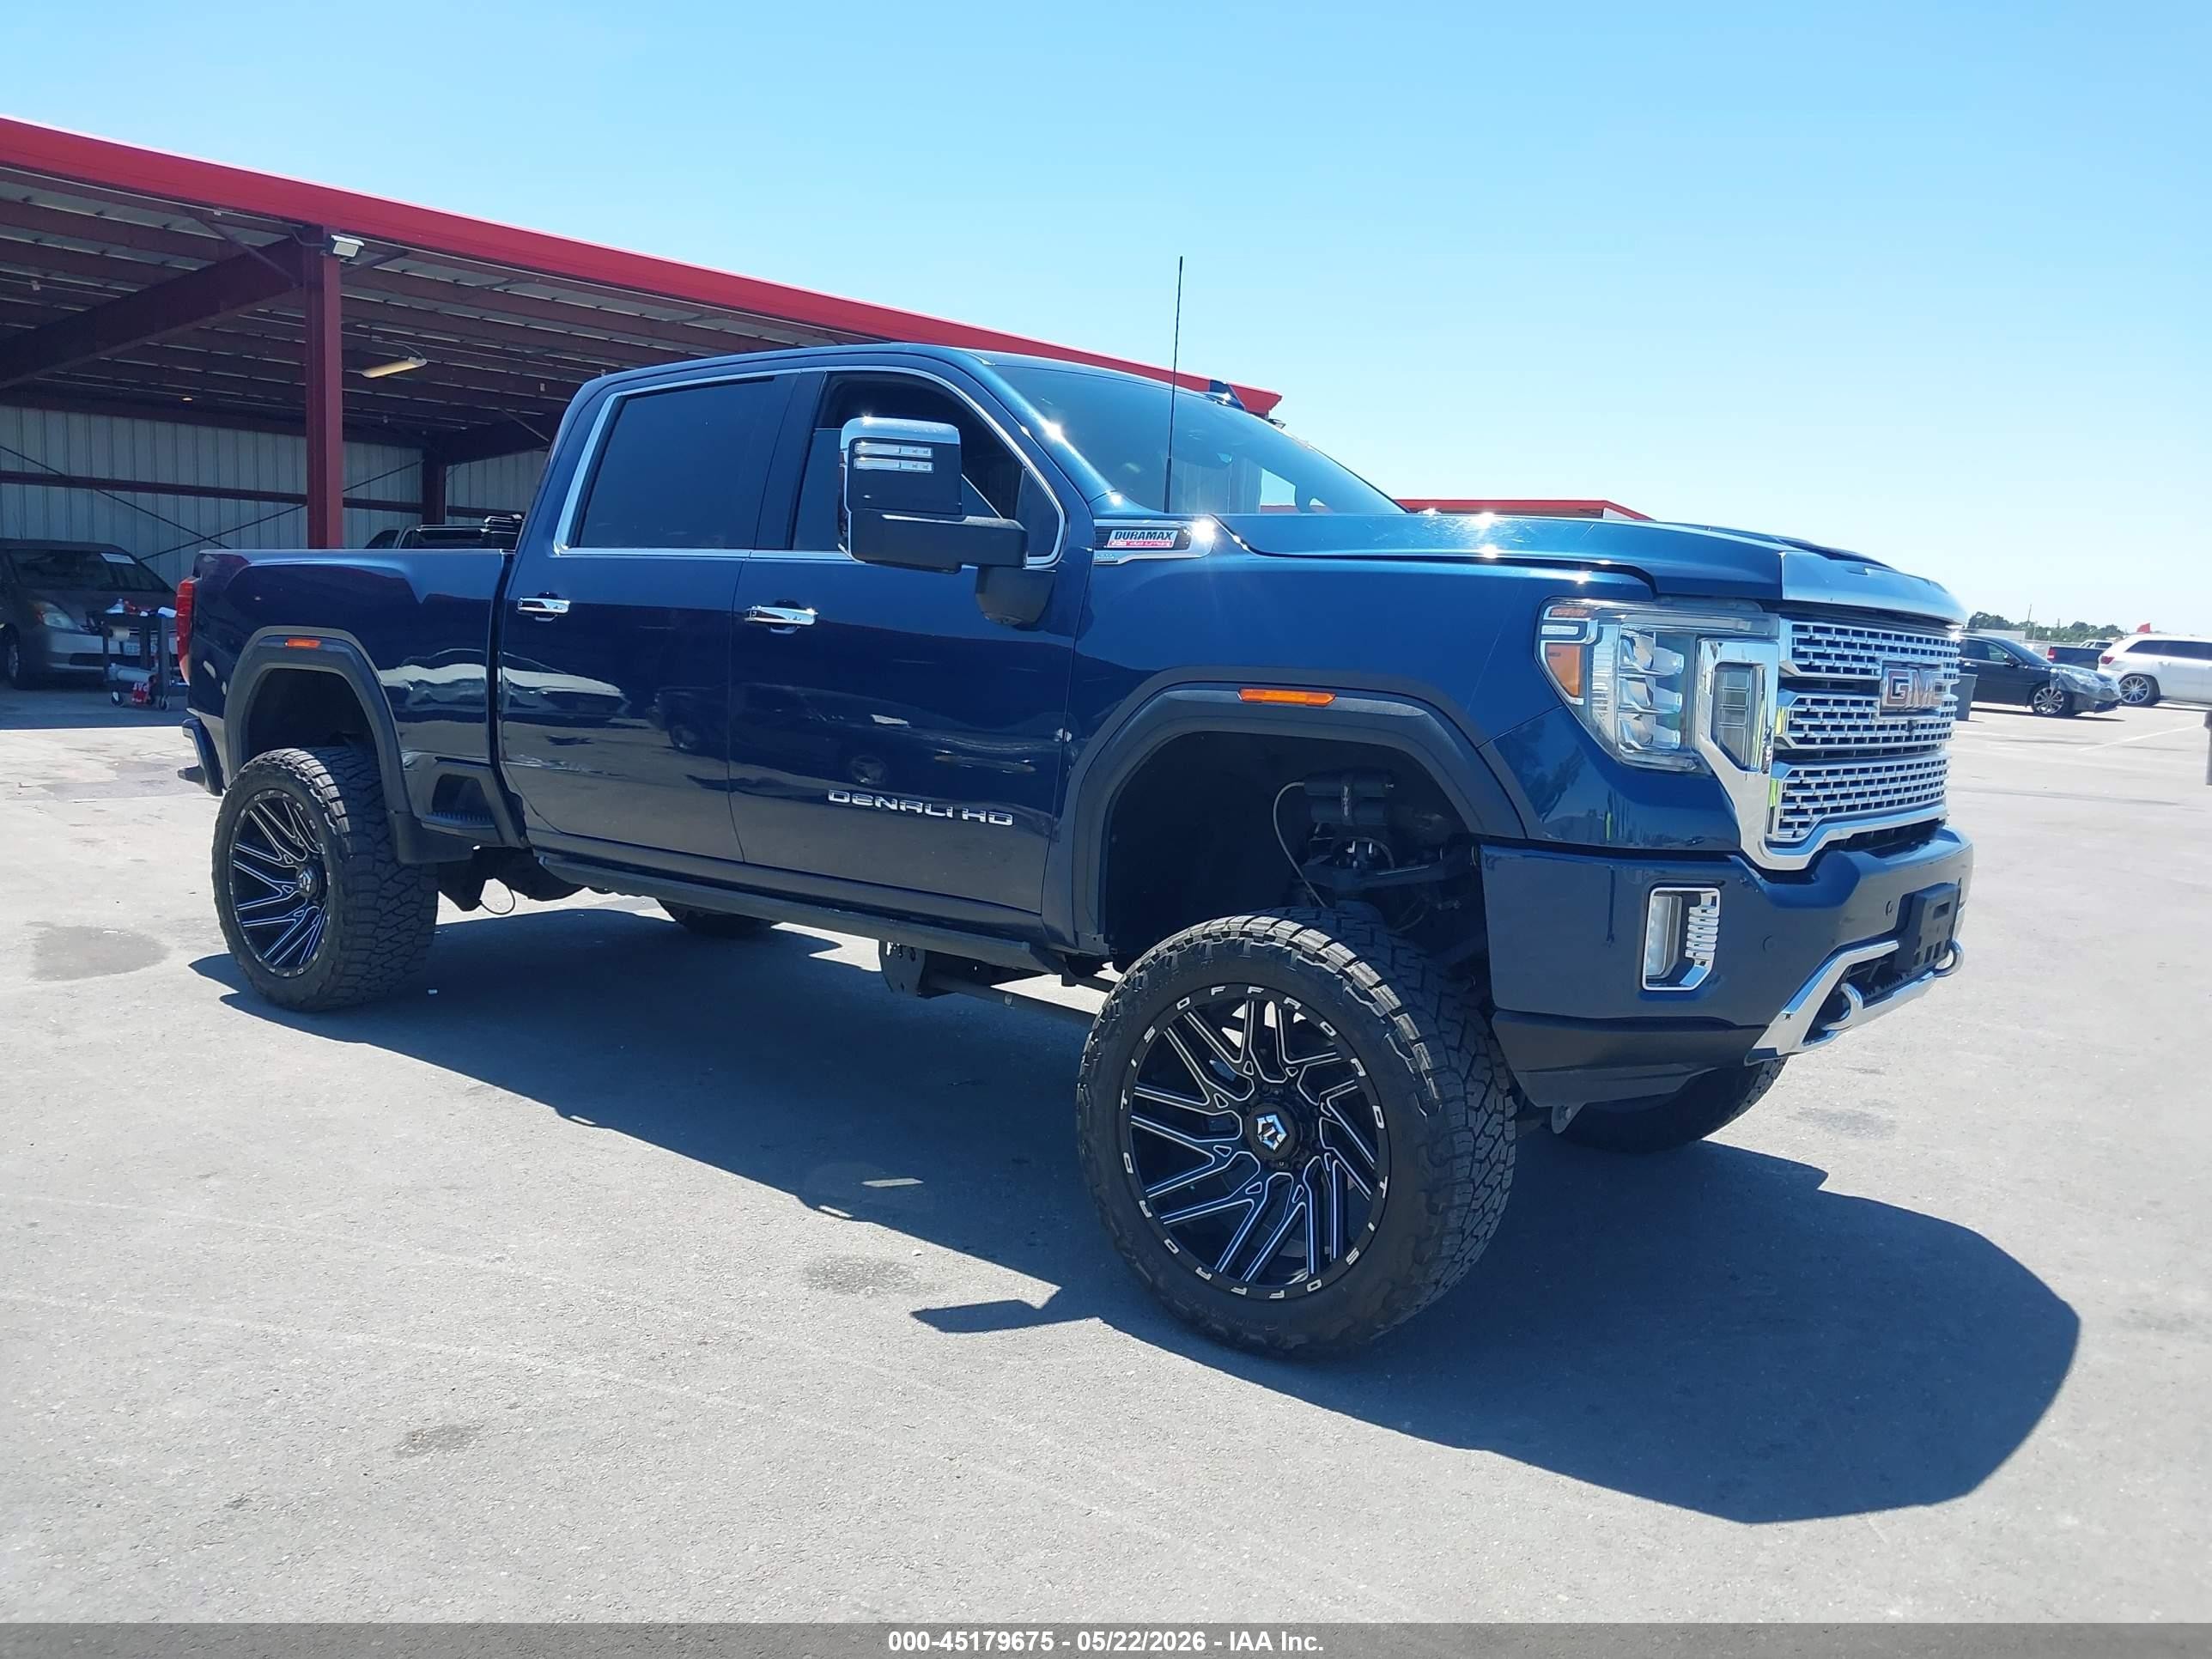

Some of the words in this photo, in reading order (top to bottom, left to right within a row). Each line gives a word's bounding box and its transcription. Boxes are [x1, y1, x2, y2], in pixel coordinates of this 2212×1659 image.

[1115, 531, 1174, 540] DURAMAX
[1882, 666, 1945, 710] GMC
[827, 789, 953, 818] DENALI
[961, 807, 1014, 826] HD
